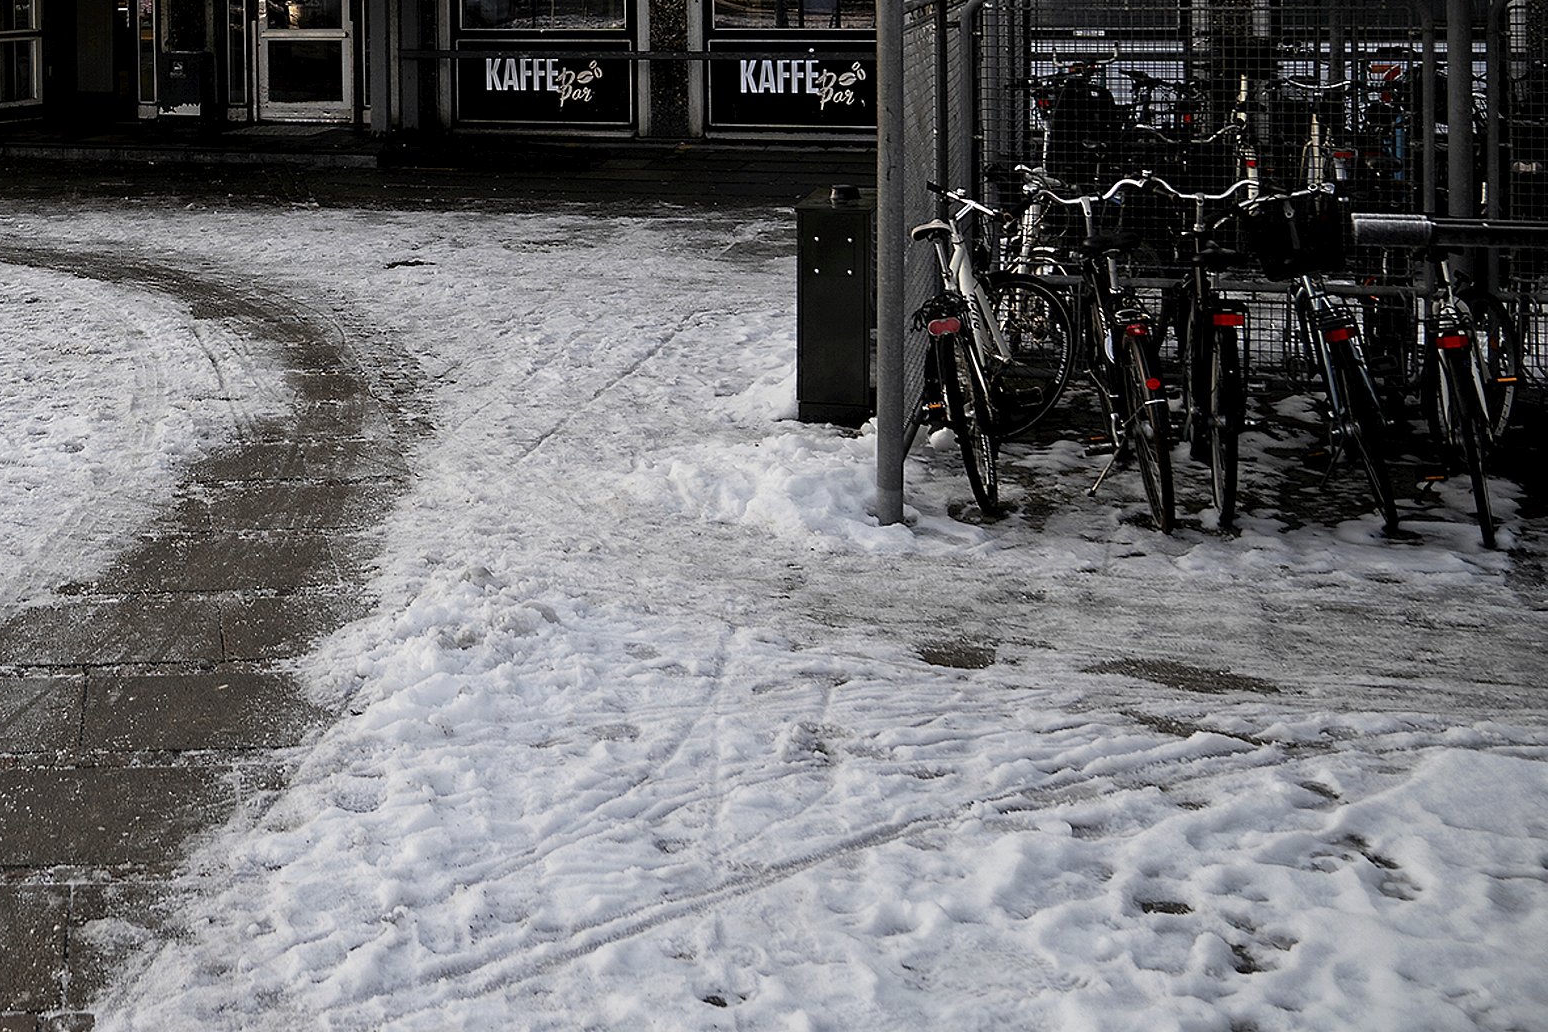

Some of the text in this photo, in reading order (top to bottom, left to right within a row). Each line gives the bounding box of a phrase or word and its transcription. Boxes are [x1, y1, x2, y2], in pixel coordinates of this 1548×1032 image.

[485, 58, 594, 107] KAFFE Bar
[739, 59, 856, 110] KAFFE Bar
